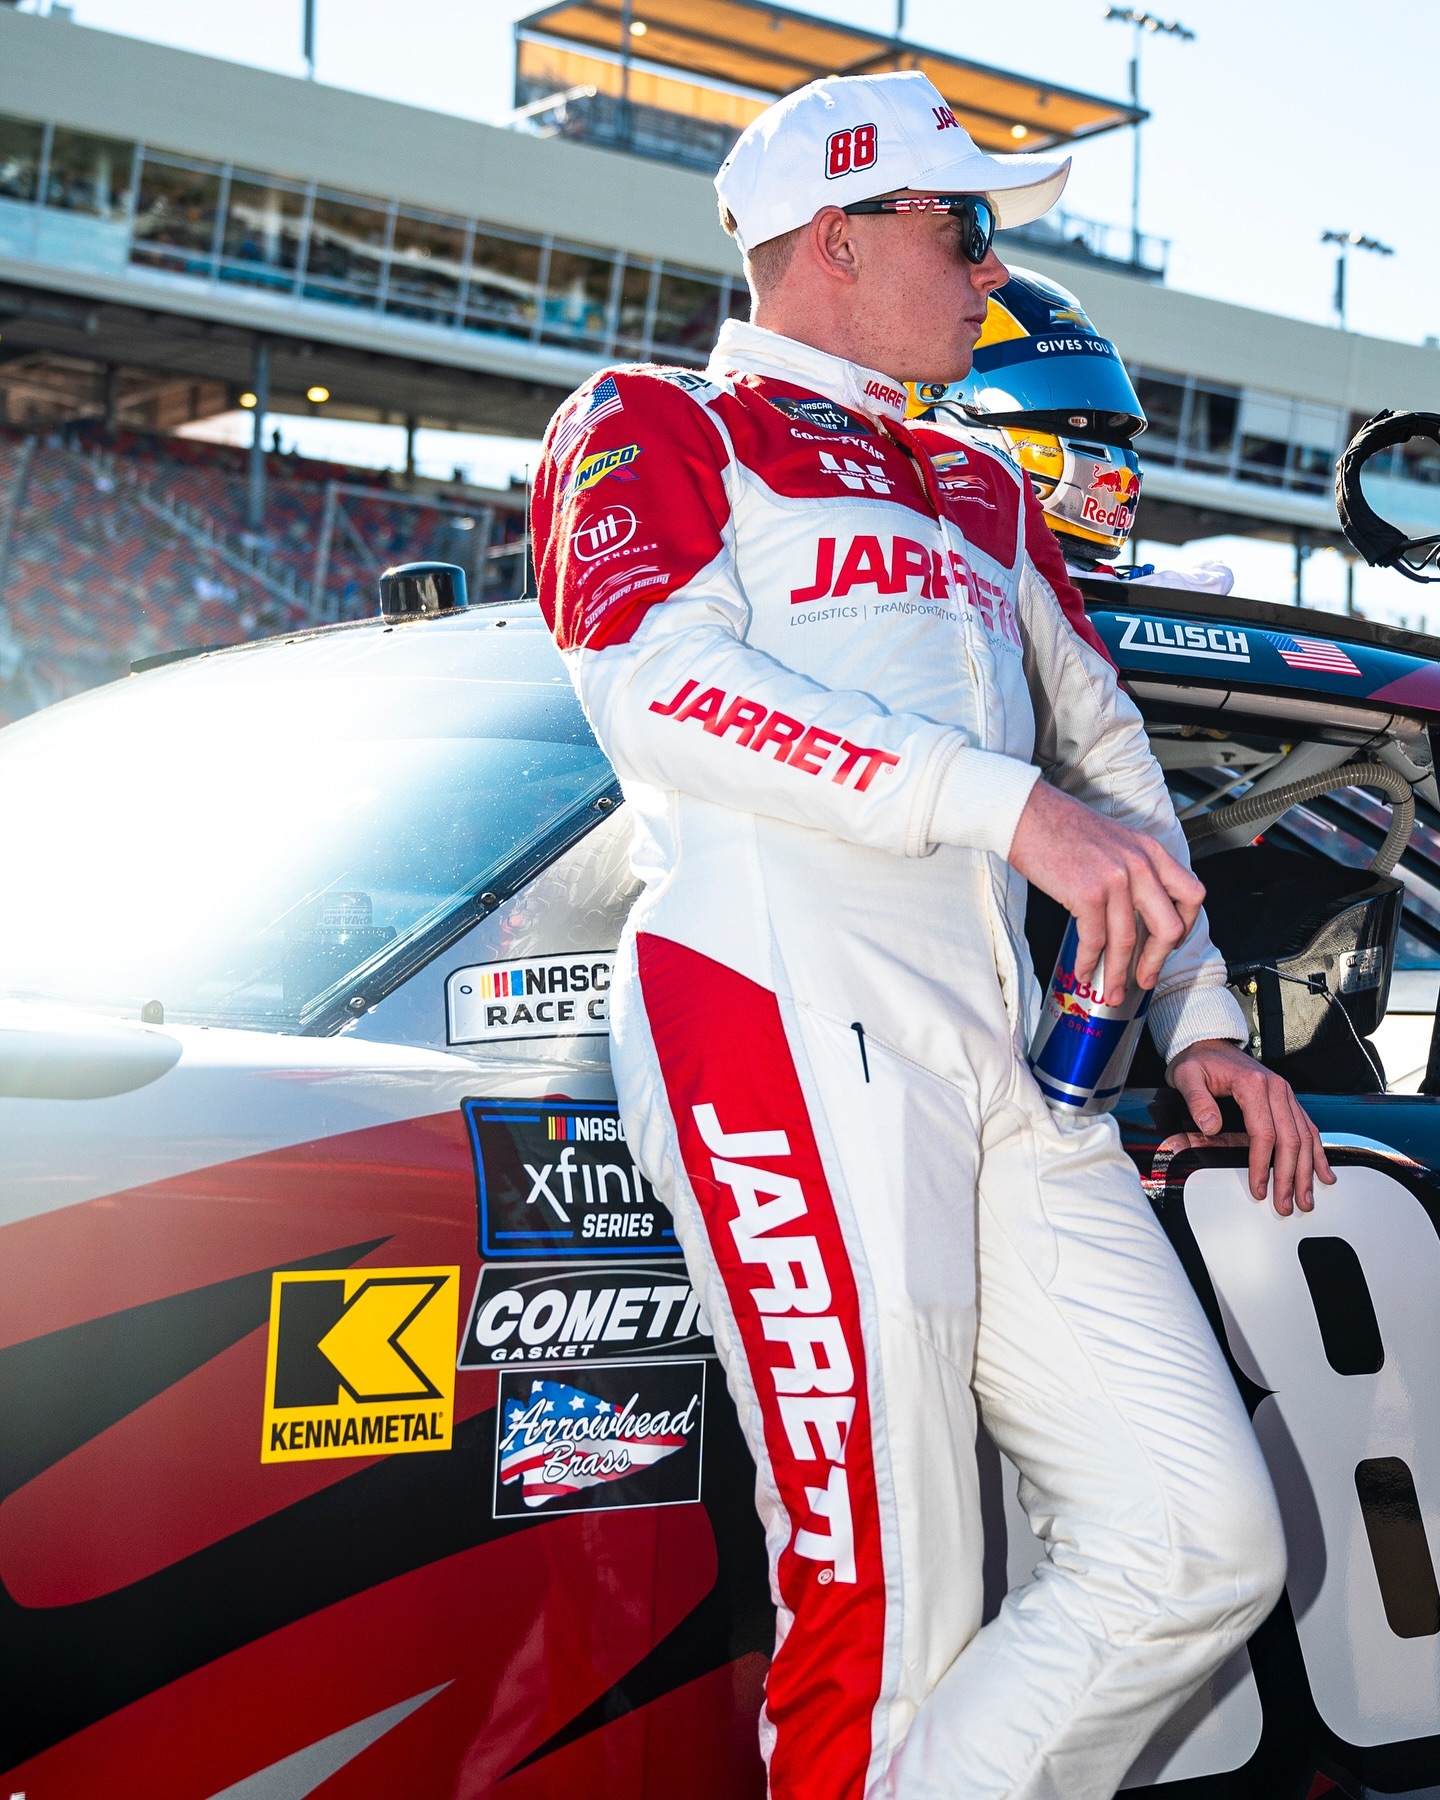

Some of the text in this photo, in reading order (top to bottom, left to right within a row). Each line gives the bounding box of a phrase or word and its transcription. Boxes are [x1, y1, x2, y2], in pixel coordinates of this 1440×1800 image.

[828, 124, 876, 178] 88
[1036, 339, 1110, 354] GIVES YOU
[577, 542, 658, 588] TRACKHOUSE
[632, 573, 671, 591] Racing
[790, 606, 858, 627] LOGISTICS
[1115, 615, 1251, 663] ZILISCH
[648, 678, 901, 793] JARRETT
[525, 963, 615, 996] NASC
[487, 998, 610, 1027] RACE C
[1067, 1019, 1103, 1038] DRINK
[581, 1213, 655, 1238] SERIES
[490, 1343, 595, 1362] GASKET
[692, 1103, 857, 1585] JARRETT
[270, 1412, 444, 1451] KENNAMETAL
[499, 1392, 699, 1451] Arrowhead
[542, 1440, 632, 1484] Brass
